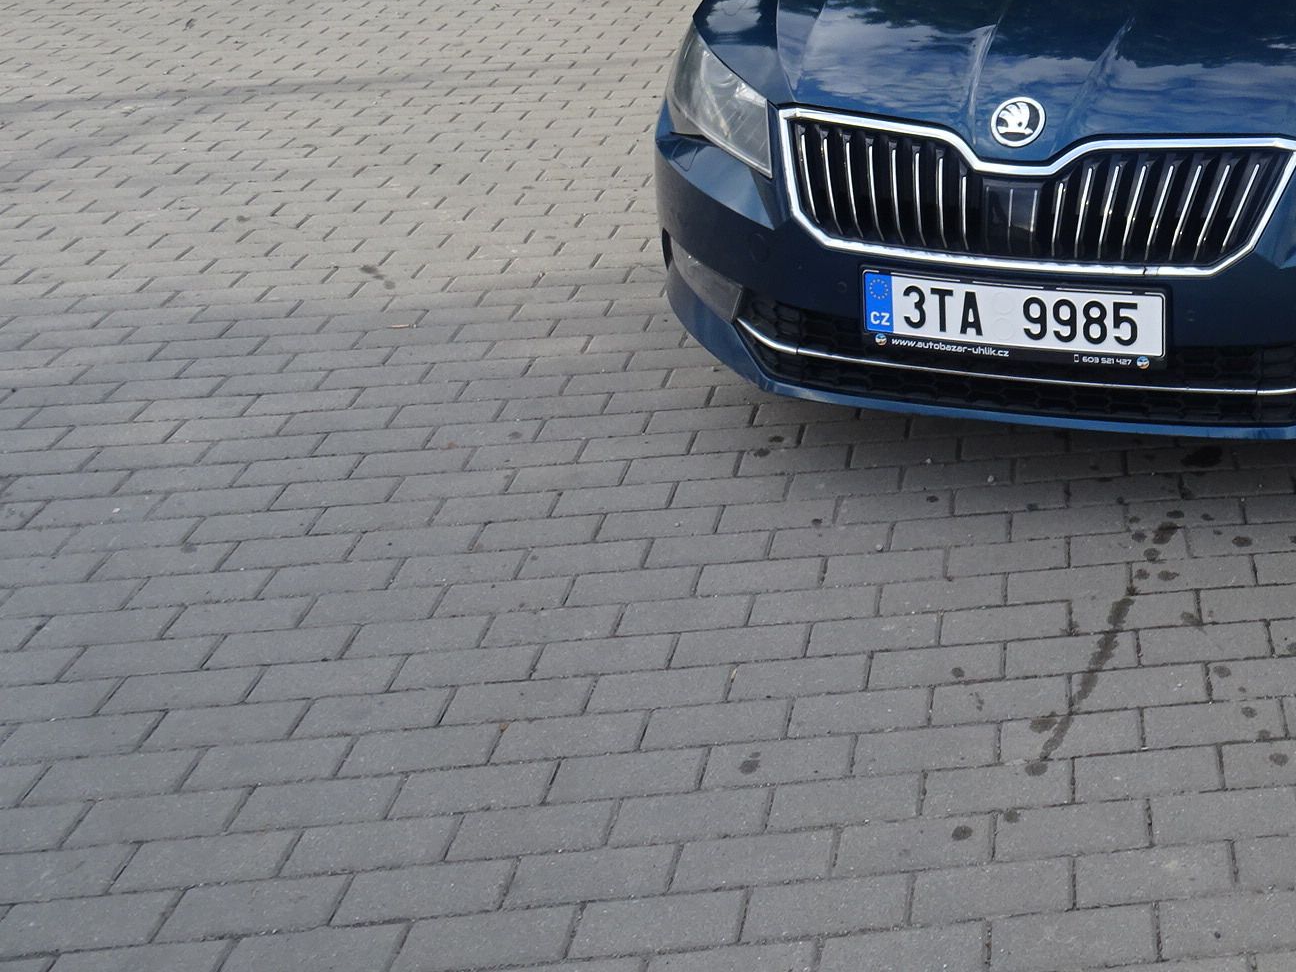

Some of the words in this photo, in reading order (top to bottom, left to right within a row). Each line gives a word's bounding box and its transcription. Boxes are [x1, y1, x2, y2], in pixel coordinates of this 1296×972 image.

[870, 311, 891, 327] CZ
[902, 285, 984, 336] 3TA
[1022, 296, 1139, 347] 9985
[891, 337, 1009, 357] www.autobazar-uhlik.cz
[1116, 358, 1132, 366] 427
